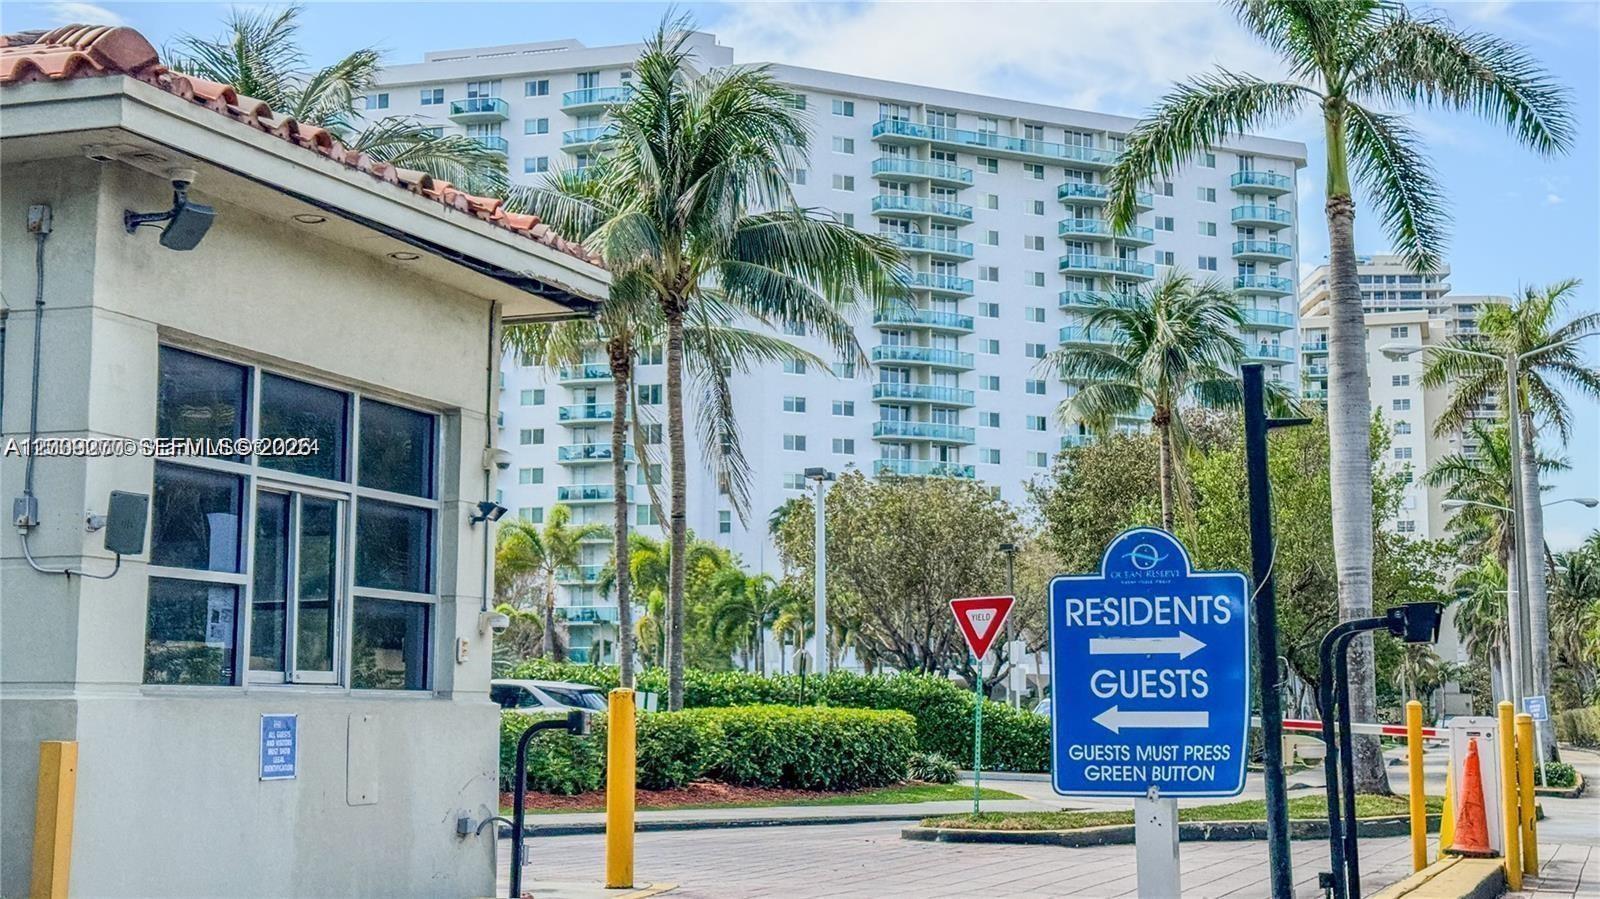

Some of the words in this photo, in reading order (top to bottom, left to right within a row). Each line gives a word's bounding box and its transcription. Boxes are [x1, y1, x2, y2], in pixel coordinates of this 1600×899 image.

[1110, 570, 1142, 579] OCEAN
[971, 613, 991, 622] YIELD
[1065, 594, 1232, 627] RESIDENTS
[1090, 668, 1209, 699] GUESTS
[1068, 744, 1130, 761] GUESTS
[1136, 744, 1180, 761] MUST
[1184, 744, 1231, 761] PRESS
[1084, 765, 1147, 782] GREEN
[1152, 765, 1215, 782] BUTTON
